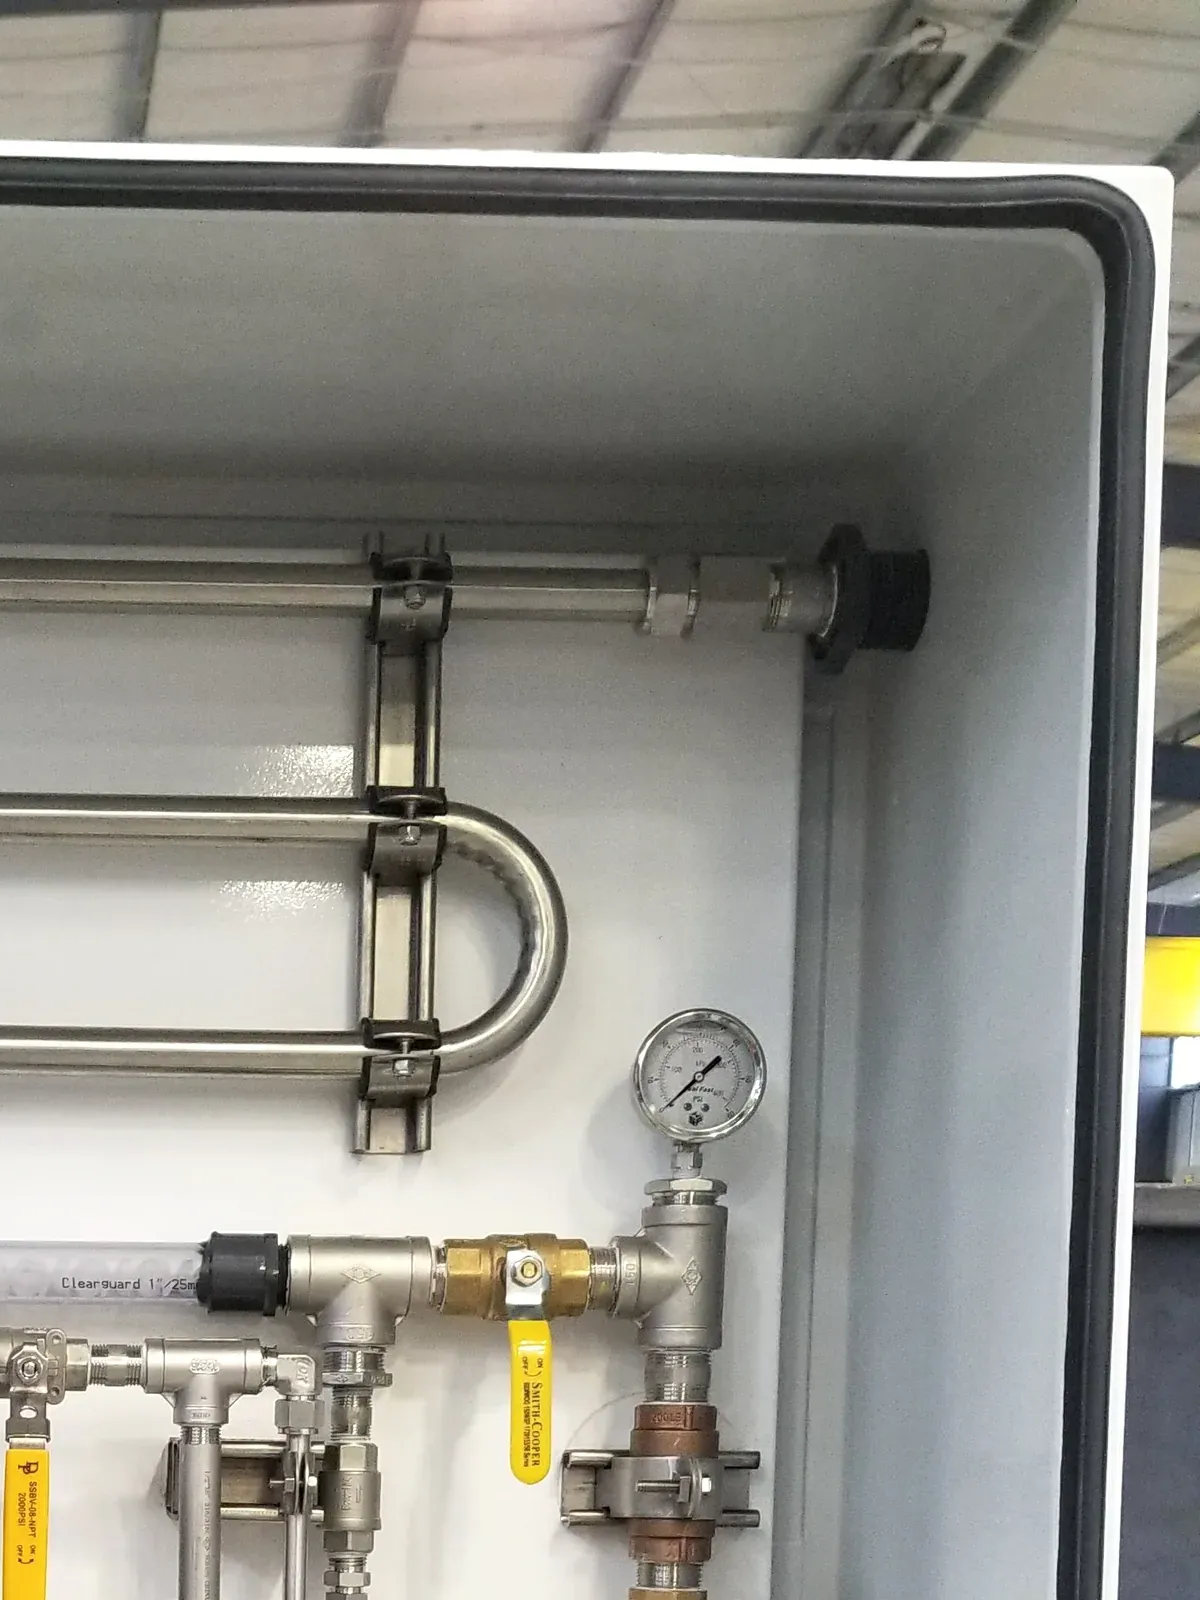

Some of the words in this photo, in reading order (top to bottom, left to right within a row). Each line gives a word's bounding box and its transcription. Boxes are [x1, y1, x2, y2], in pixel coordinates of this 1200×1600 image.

[61, 1277, 141, 1290] Clearguard
[148, 1278, 198, 1291] 1"/25m
[531, 1382, 544, 1467] SMITH-COOPER
[29, 1481, 37, 1538] SSBV-08-NPT
[30, 1545, 36, 1554] ON
